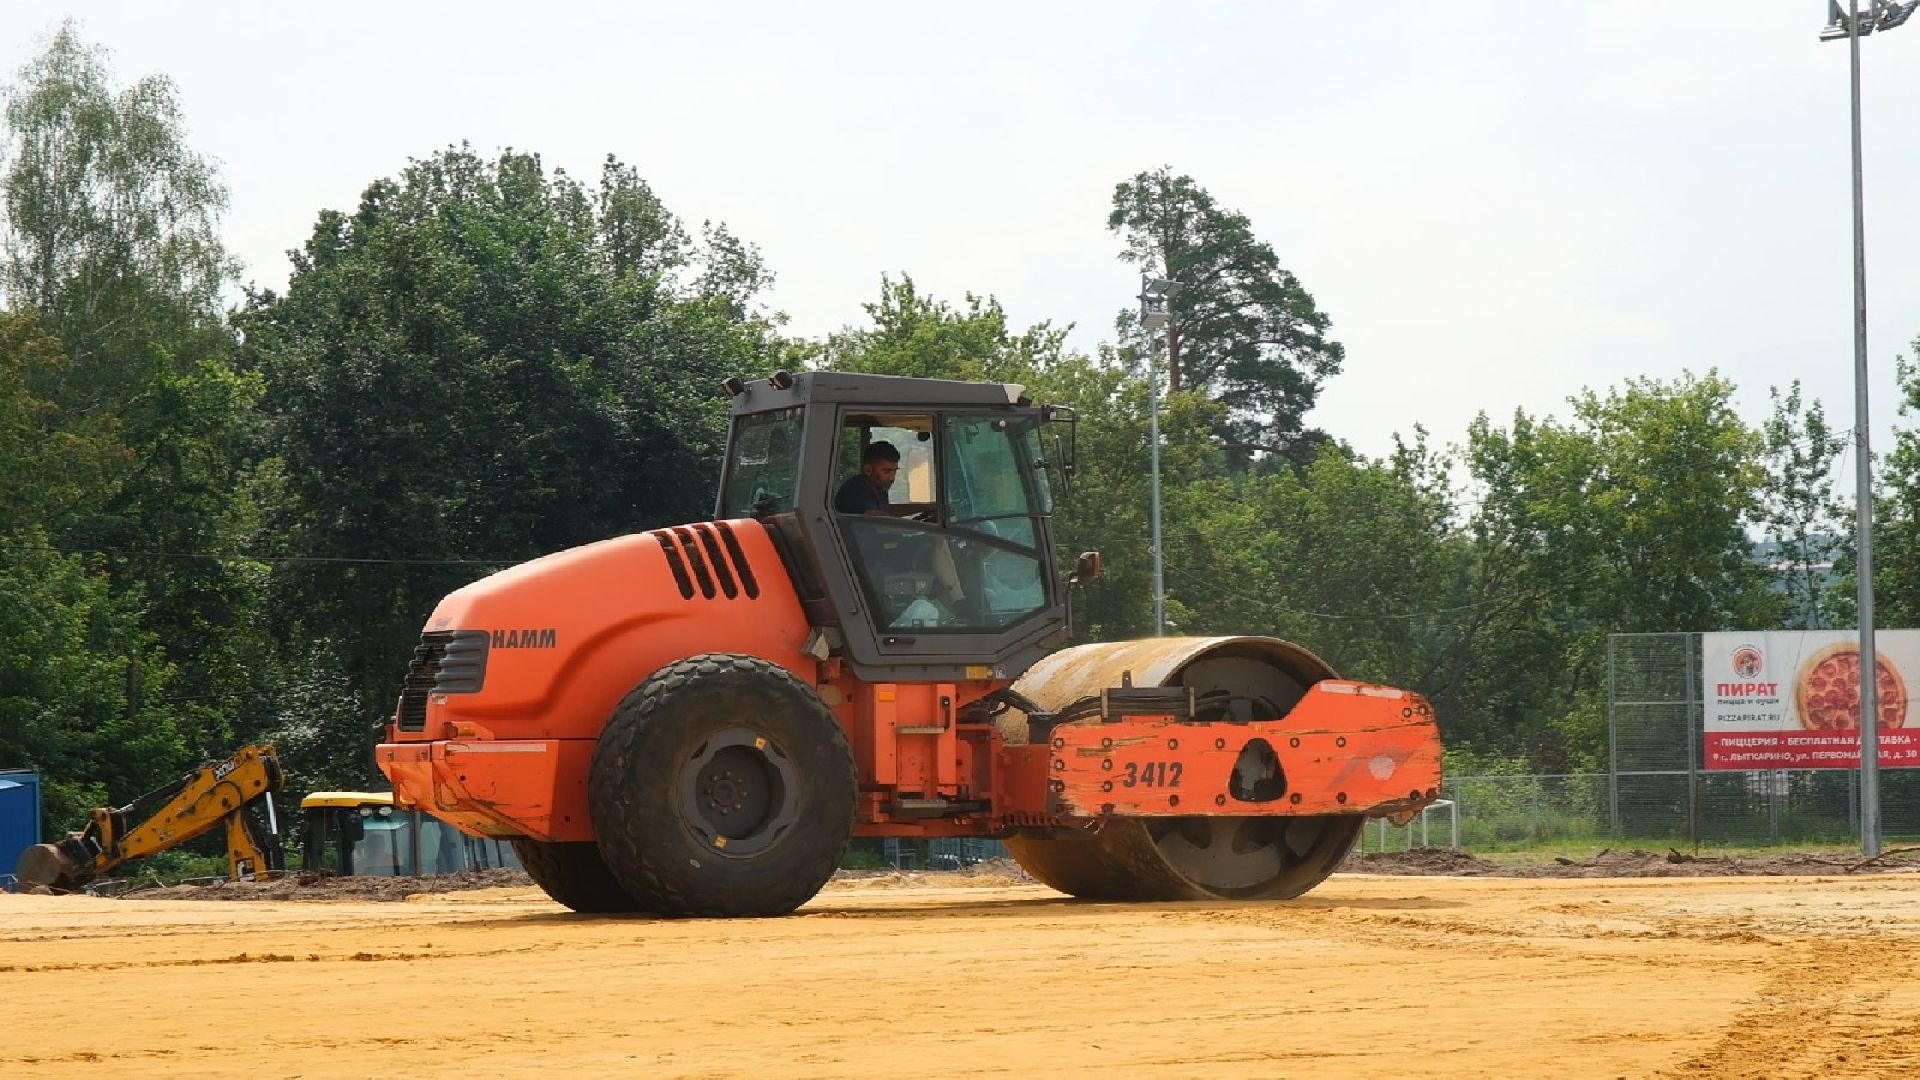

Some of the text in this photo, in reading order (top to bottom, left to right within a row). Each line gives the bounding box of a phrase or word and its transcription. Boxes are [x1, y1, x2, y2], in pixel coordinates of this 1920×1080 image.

[492, 629, 556, 649] HAMM
[1717, 683, 1778, 696] ПИРАТ
[1721, 735, 1911, 747] ПИЦЦЕРИЯ БЕСПЛАТНАЯ ДТАВКА
[1123, 762, 1183, 788] 3412
